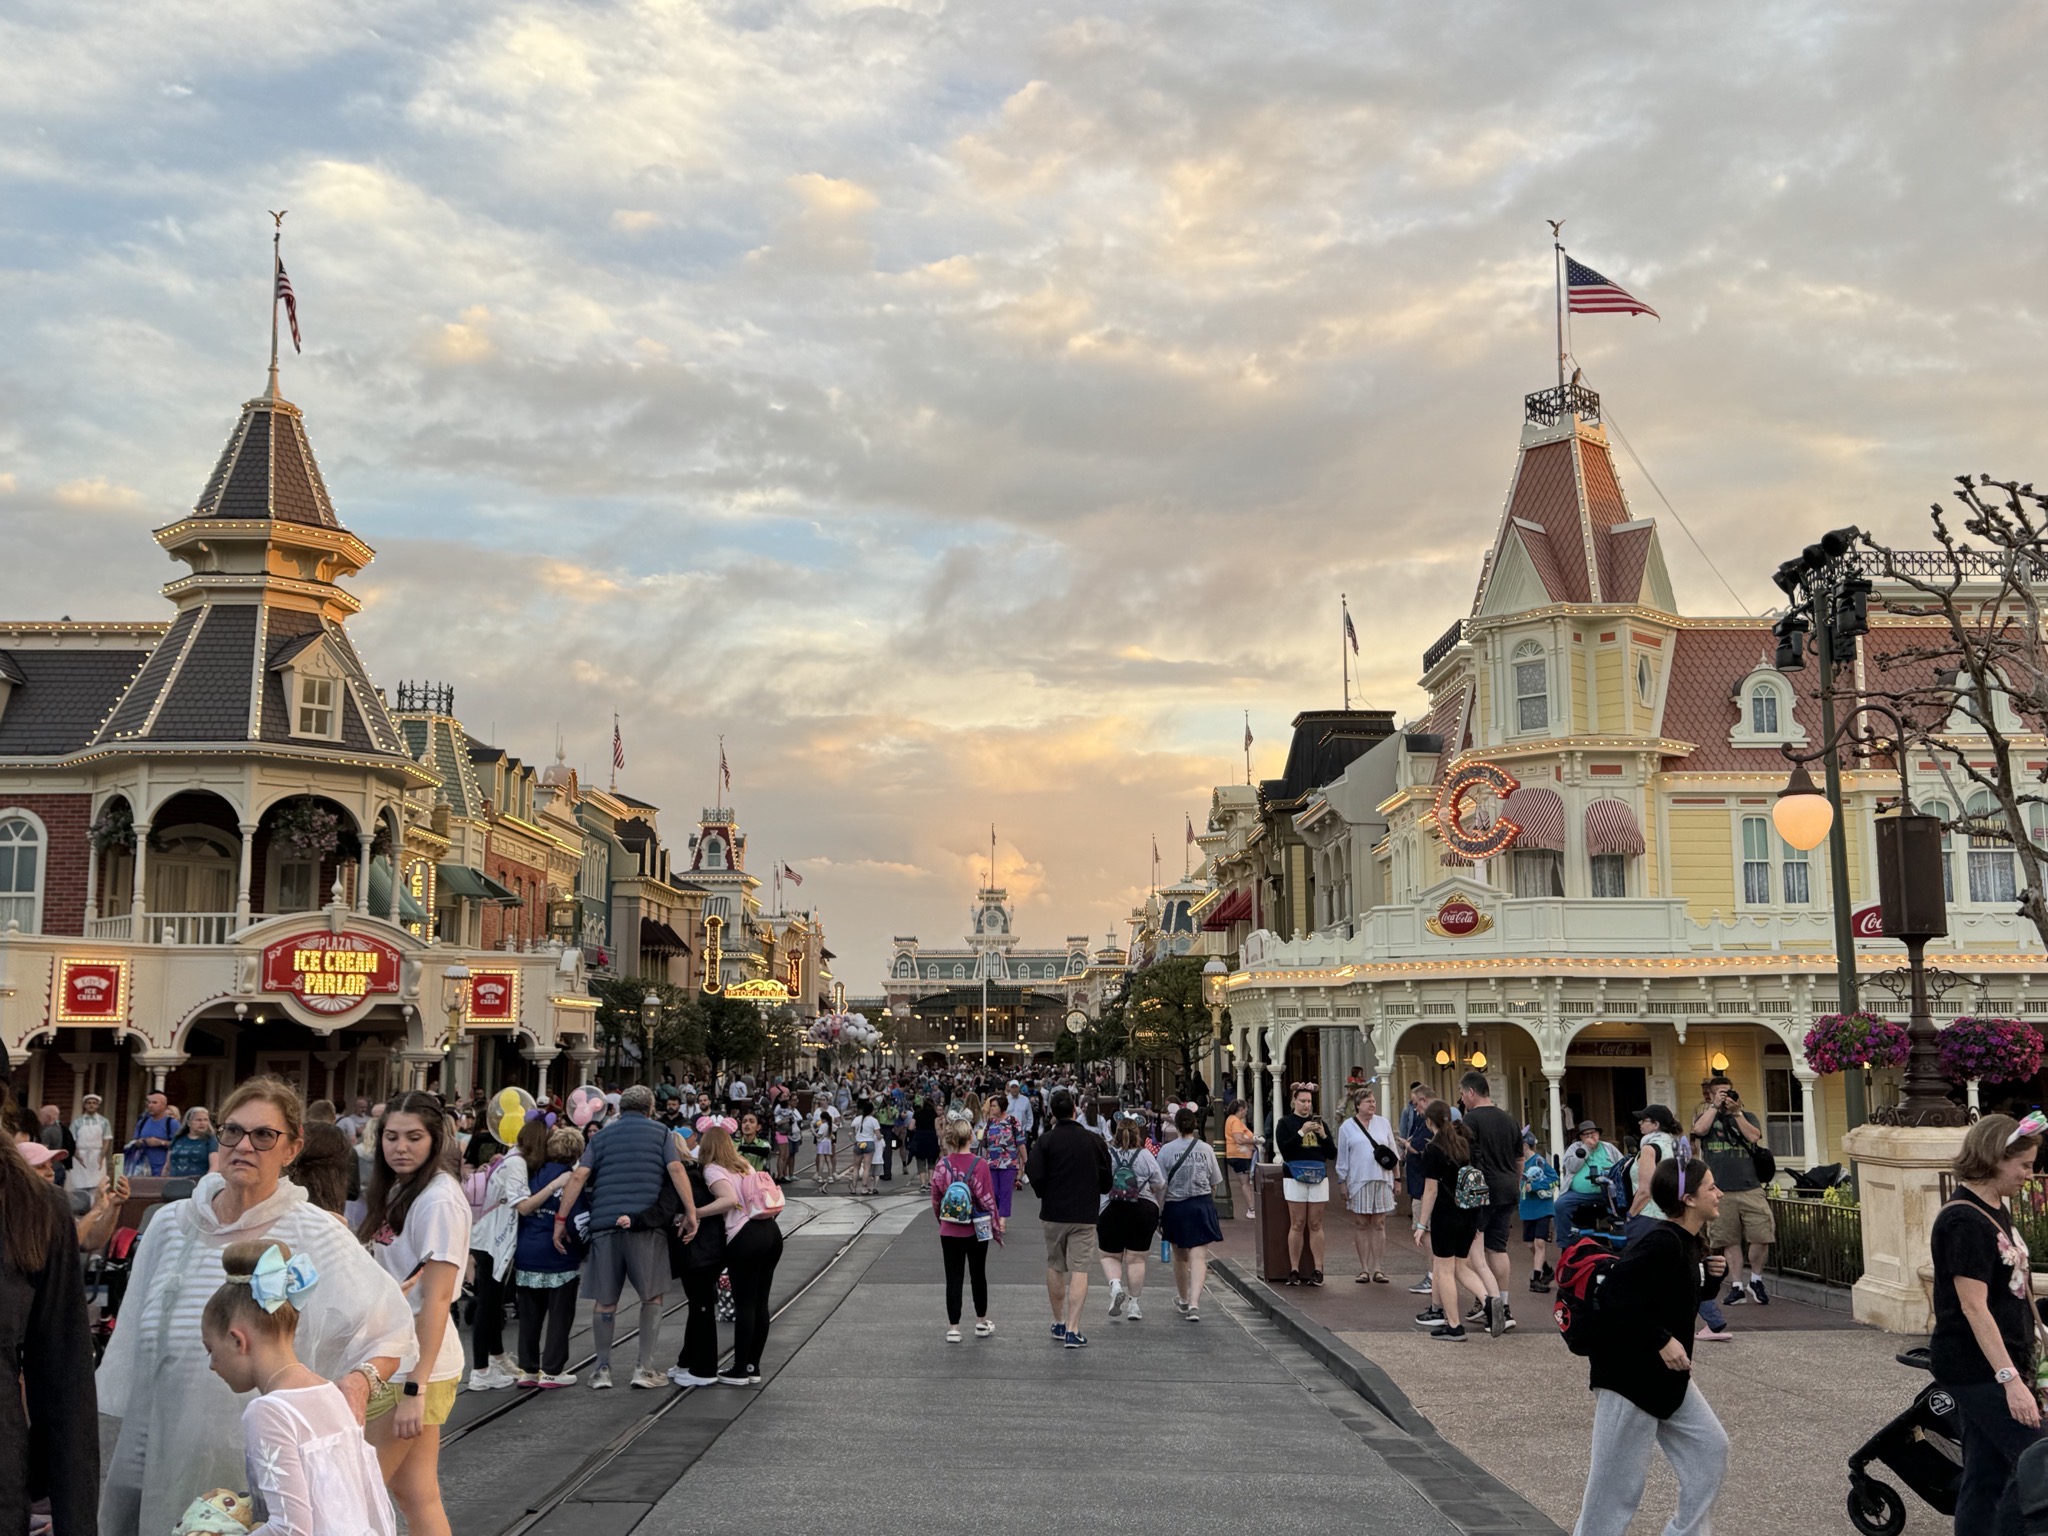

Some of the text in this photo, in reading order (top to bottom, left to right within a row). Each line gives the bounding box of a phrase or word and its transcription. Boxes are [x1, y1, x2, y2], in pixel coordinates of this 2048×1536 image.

[411, 863, 423, 897] ICE
[1440, 911, 1474, 925] Coca-Cola
[319, 936, 352, 951] PLAZA
[293, 950, 379, 973] ICE CREAM
[304, 972, 367, 996] PARLOR
[1600, 1042, 1633, 1055] Coca-Cola
